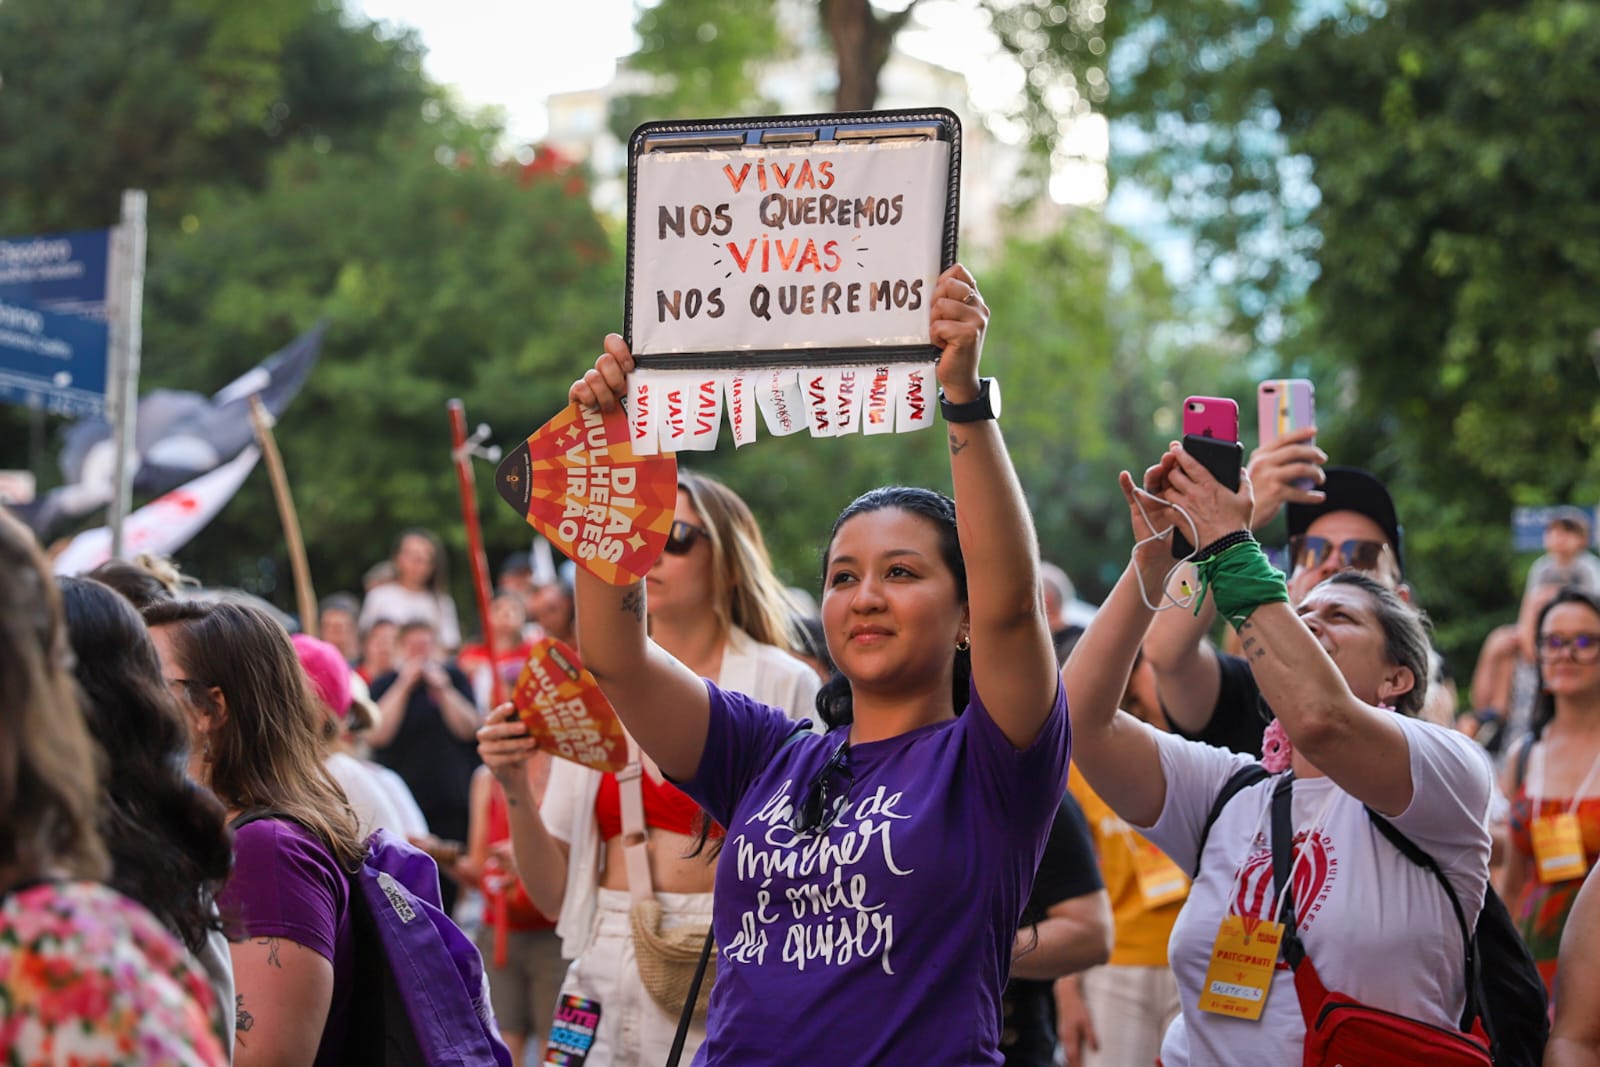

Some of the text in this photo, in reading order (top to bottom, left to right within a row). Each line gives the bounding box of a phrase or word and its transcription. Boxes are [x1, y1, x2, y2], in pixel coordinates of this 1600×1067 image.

[657, 193, 903, 240] NOS QUEREMOS
[657, 279, 923, 322] NOS QUEREMOS
[577, 403, 610, 561] MULHERES
[598, 467, 637, 564] DIAS
[567, 697, 608, 762] DIAS
[855, 786, 912, 821] de
[757, 866, 886, 924] é onde
[1303, 836, 1338, 932] DE MULHERES
[723, 911, 896, 975] ela quiser
